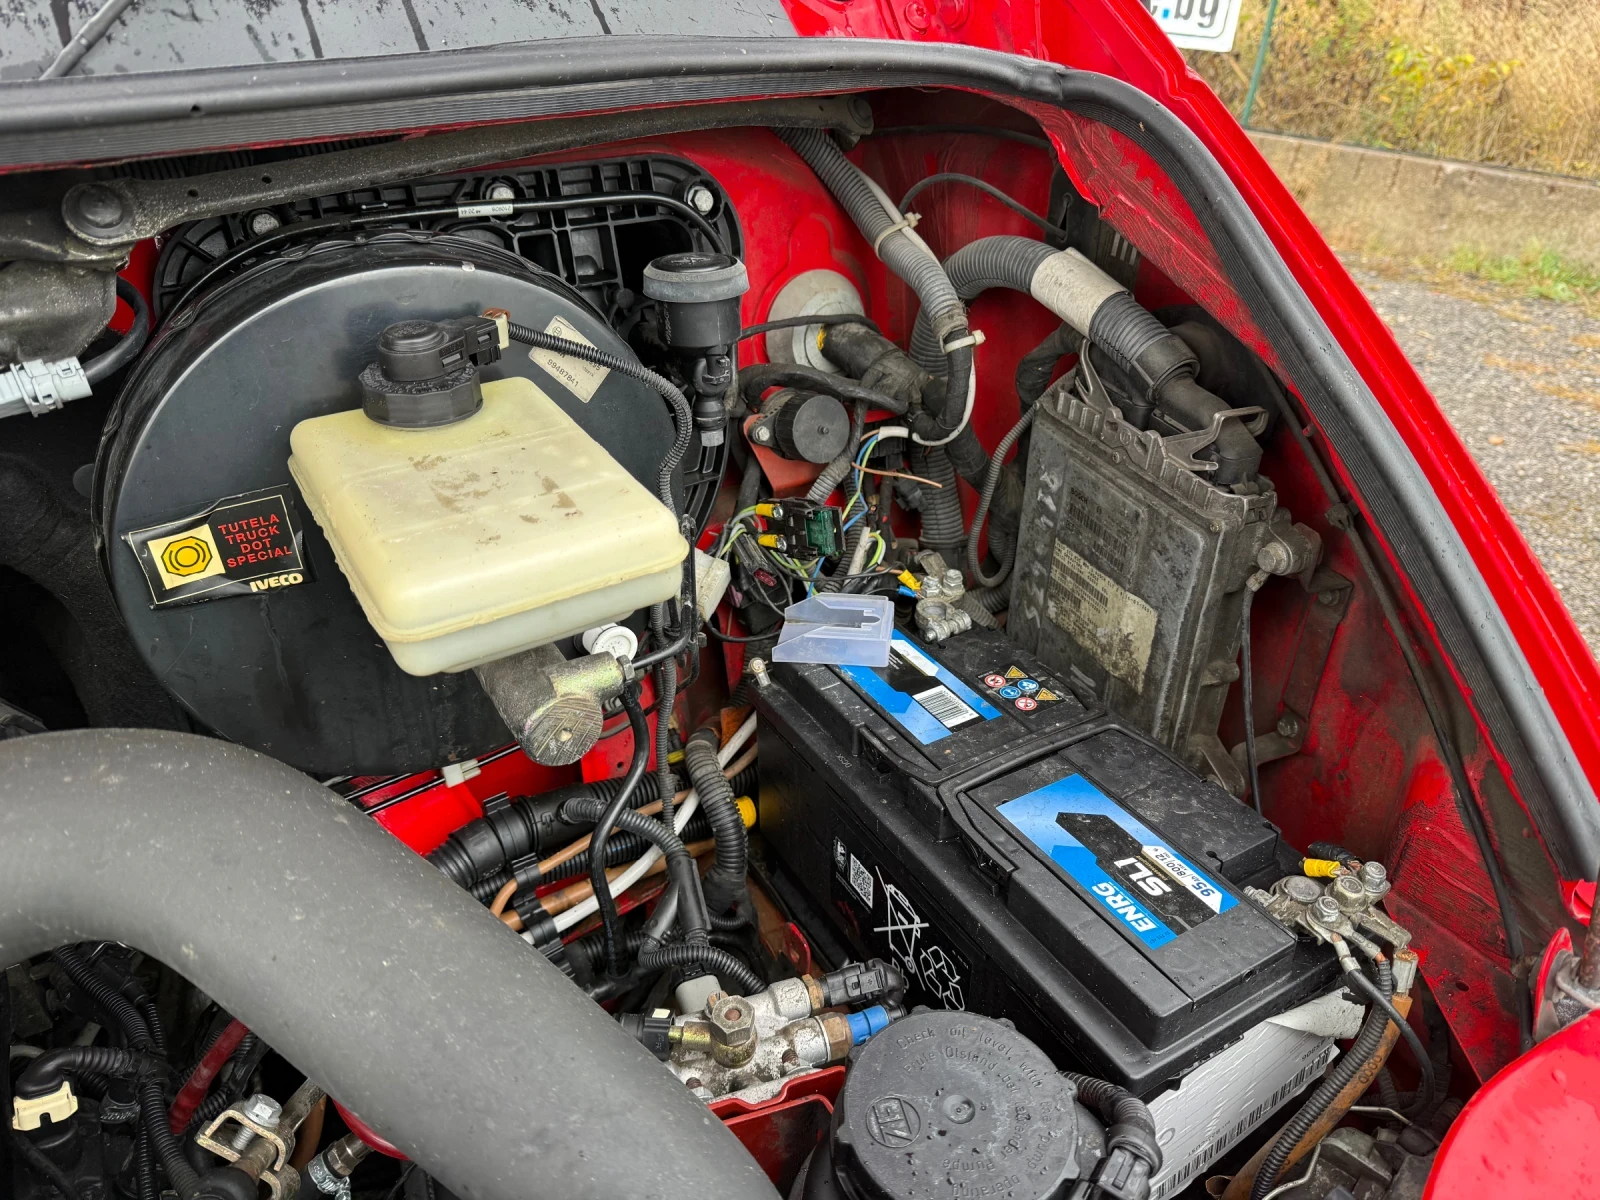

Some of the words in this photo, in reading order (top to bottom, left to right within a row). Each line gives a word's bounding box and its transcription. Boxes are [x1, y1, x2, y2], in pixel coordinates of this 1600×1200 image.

[547, 359, 579, 387] 99487841
[218, 513, 279, 534] TUTELA
[225, 525, 280, 545] TRUCK
[226, 545, 292, 568] SPECIAL
[239, 538, 272, 554] DOT
[250, 572, 303, 593] IVECO
[1113, 857, 1173, 897] SLI
[1091, 881, 1160, 932] ENRG
[895, 1027, 936, 1050] Check
[949, 1026, 966, 1039] oil
[1019, 1061, 1045, 1089] with
[942, 1157, 996, 1172] Pumpe
[951, 1172, 1021, 1198] operating
